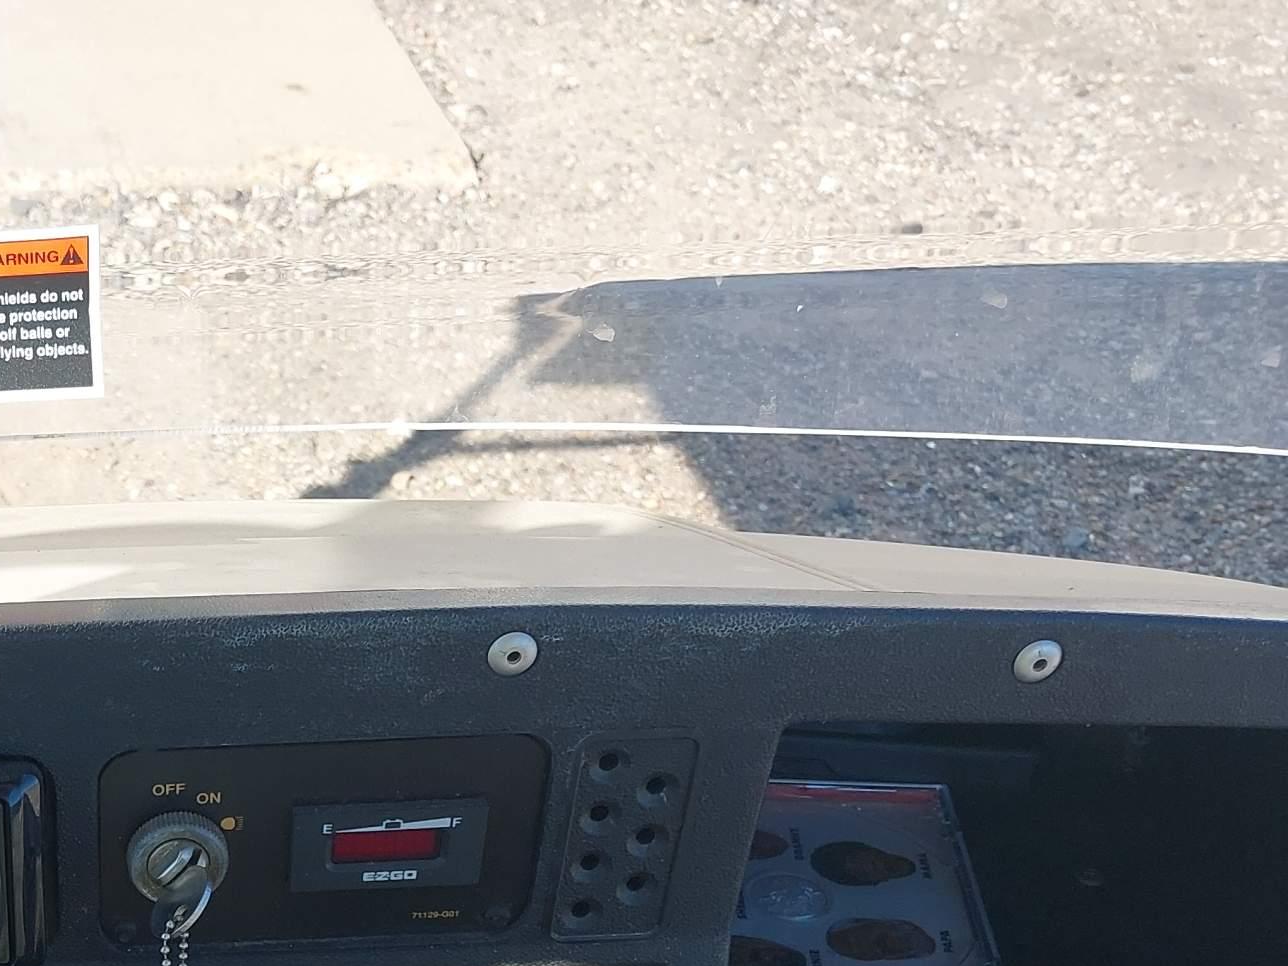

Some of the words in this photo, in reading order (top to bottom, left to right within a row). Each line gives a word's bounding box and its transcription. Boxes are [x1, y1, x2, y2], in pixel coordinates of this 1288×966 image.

[40, 290, 58, 303] do
[61, 289, 83, 302] not
[10, 308, 77, 326] protection
[20, 325, 52, 340] balls
[56, 327, 70, 338] or
[36, 342, 89, 359] objects.
[152, 783, 186, 796] OFF
[196, 792, 221, 804] ON
[452, 817, 463, 827] F
[323, 824, 333, 834] E
